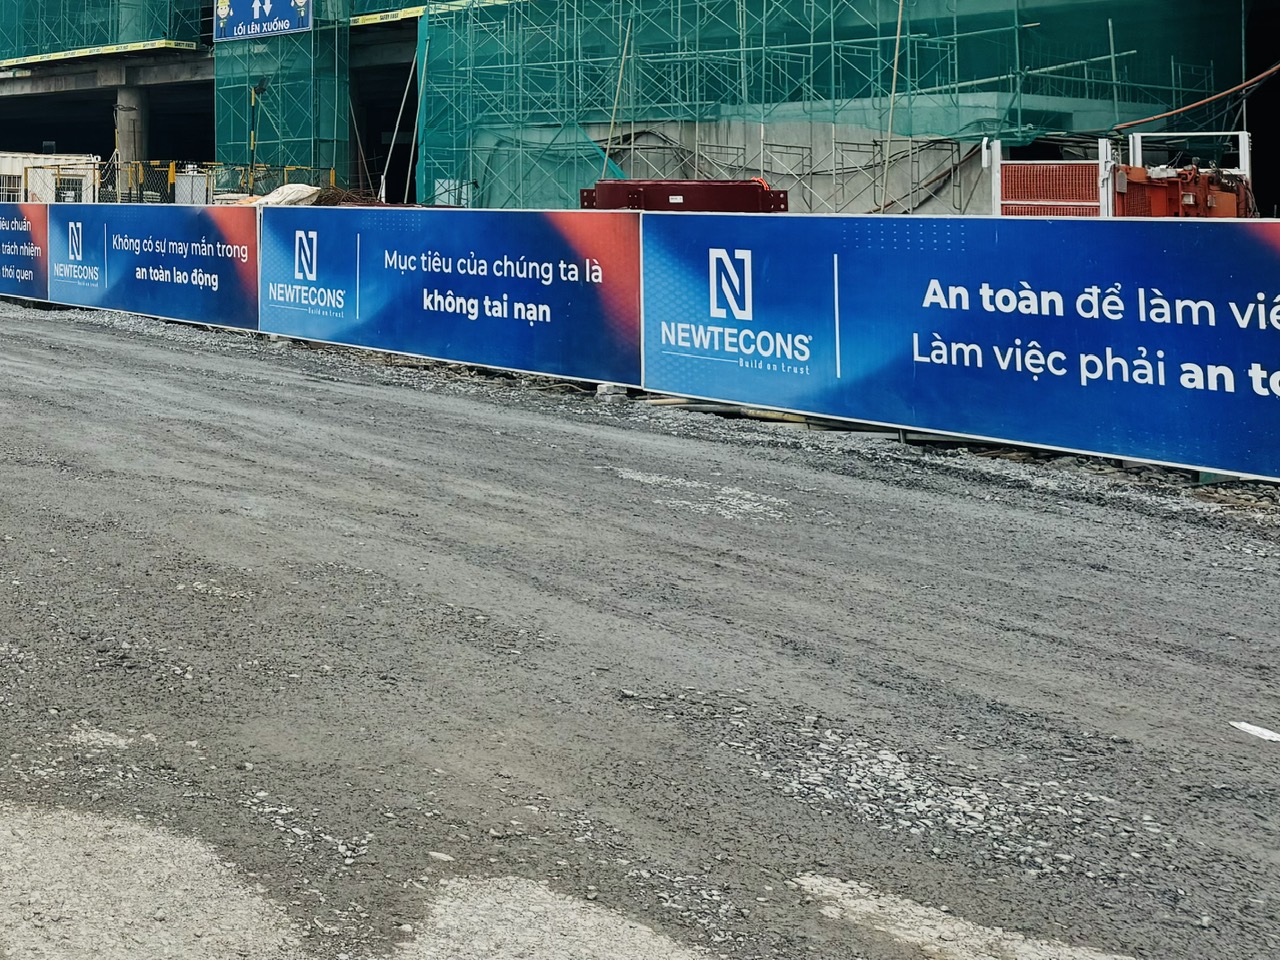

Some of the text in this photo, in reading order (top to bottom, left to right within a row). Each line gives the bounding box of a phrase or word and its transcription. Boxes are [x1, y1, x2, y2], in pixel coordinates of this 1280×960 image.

[233, 16, 290, 36] LỐI LÊN XUỐNG
[2, 240, 18, 256] trách
[19, 241, 42, 260] nhiệm
[112, 234, 248, 263] Không có sự may mắn trong
[2, 263, 15, 279] thói
[15, 266, 34, 283] quen
[53, 262, 99, 281] NEWTECONS
[135, 265, 218, 291] an toàn lao động
[384, 249, 603, 286] Mục tiêu của chúng ta là
[268, 282, 345, 309] NEWTECONS
[423, 288, 551, 327] không tai nạn
[922, 278, 970, 311] An
[979, 280, 1064, 317] toàn
[1075, 282, 1125, 321] để
[1138, 287, 1216, 327] làm
[308, 307, 321, 316] Build
[329, 309, 344, 319] trust
[661, 321, 811, 362] NEWTECONS
[739, 357, 810, 375] Build on trust
[912, 331, 983, 369] Làm
[992, 338, 1067, 381] việc
[1080, 346, 1166, 387] phải
[1179, 361, 1235, 394] an
